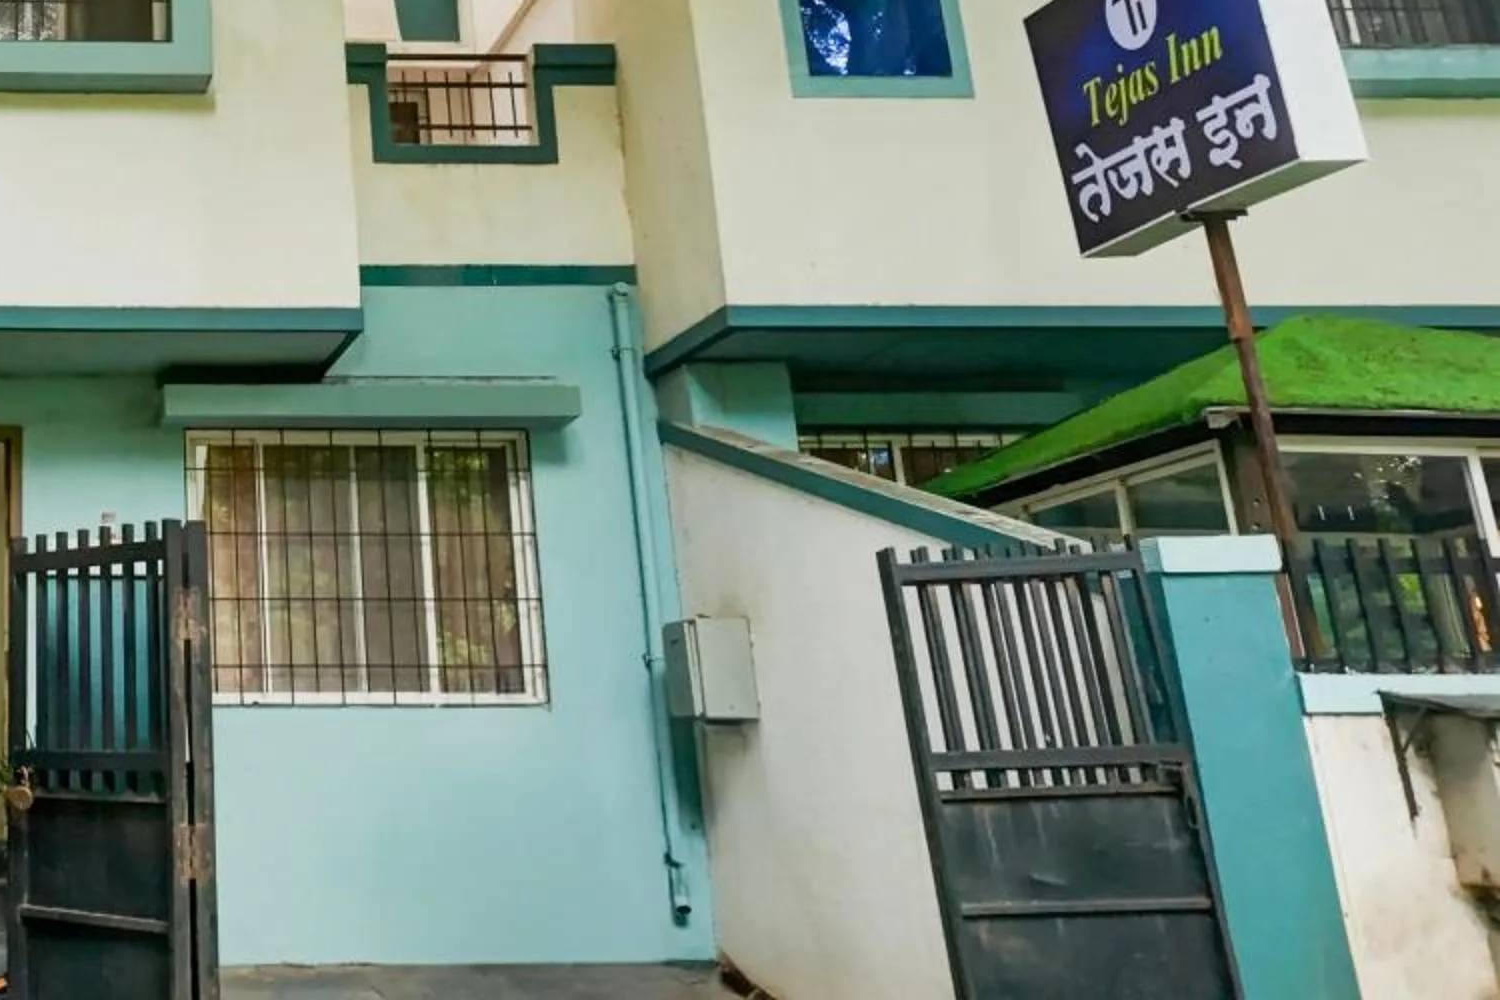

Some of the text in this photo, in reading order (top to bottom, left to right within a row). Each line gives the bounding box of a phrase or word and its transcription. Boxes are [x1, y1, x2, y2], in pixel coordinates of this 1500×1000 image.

[1082, 24, 1224, 128] Tejas Inn
[1071, 73, 1278, 223] तेजस इन
